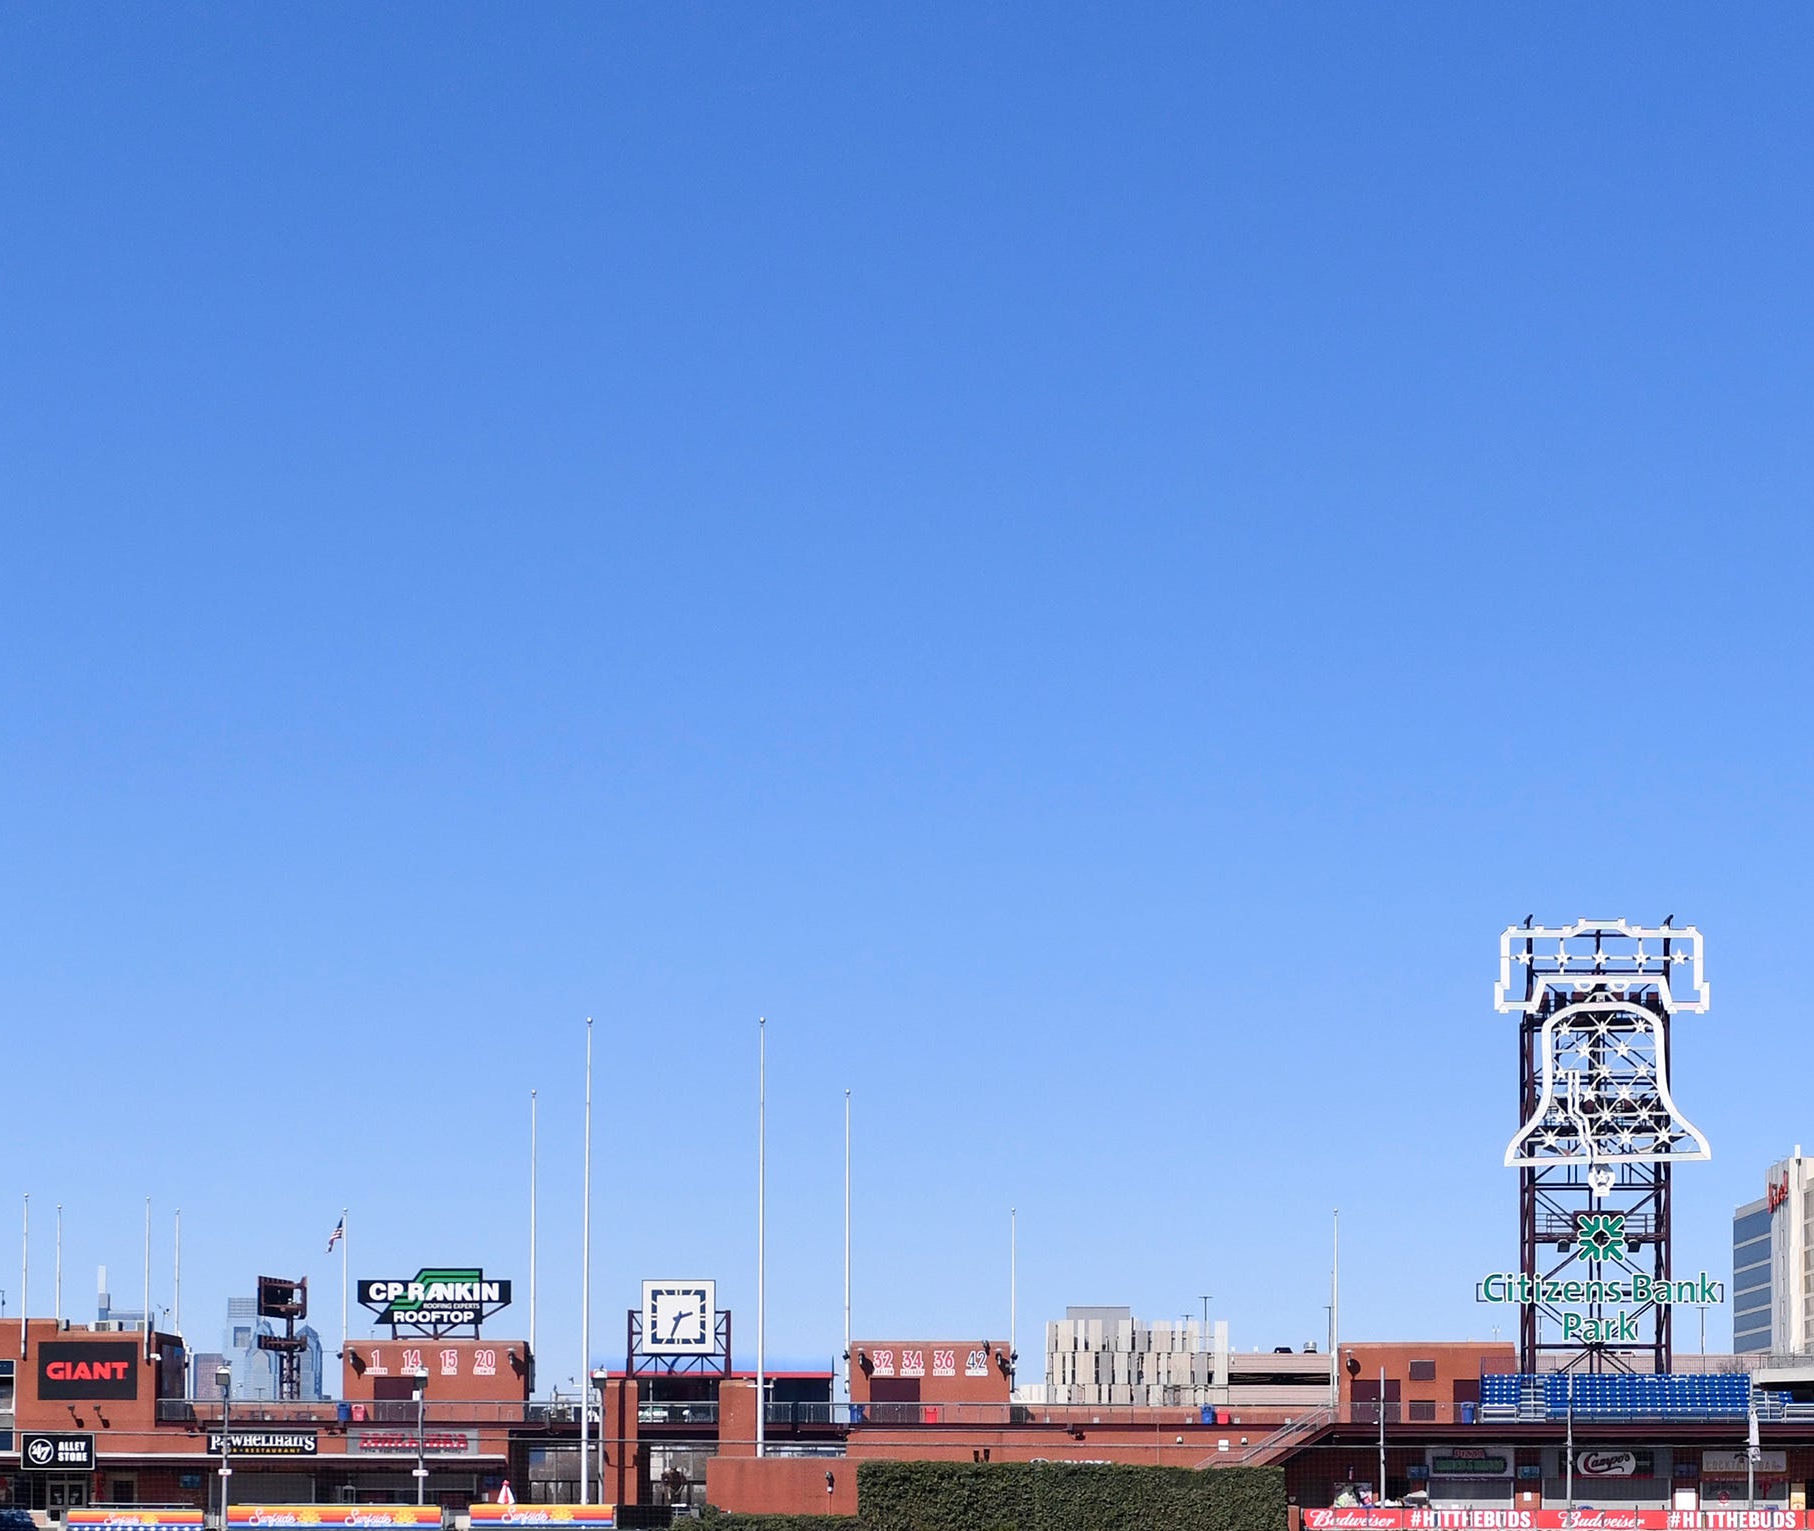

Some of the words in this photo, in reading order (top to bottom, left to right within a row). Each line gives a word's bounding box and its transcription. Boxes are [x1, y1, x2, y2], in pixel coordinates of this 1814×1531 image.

[369, 1282, 404, 1301] CP
[407, 1282, 500, 1301] RANKIN
[1482, 1273, 1622, 1304] Citizens
[1633, 1272, 1722, 1304] Bank
[393, 1311, 475, 1323] ROOFTOP
[1562, 1311, 1638, 1343] Park
[902, 1351, 923, 1369] 34
[934, 1351, 955, 1369] 36
[966, 1351, 987, 1370] 42
[46, 1360, 129, 1381] GIANT
[58, 1441, 86, 1452] ALLEY
[57, 1452, 87, 1462] STORE
[1584, 1452, 1631, 1473] Campo's
[344, 1508, 392, 1527] Surfside
[500, 1505, 548, 1525] Surfside
[1310, 1510, 1395, 1528] Budweiser
[1411, 1511, 1531, 1528] #HITTHEBUDS
[1669, 1511, 1797, 1529] #HITTHEBUDS
